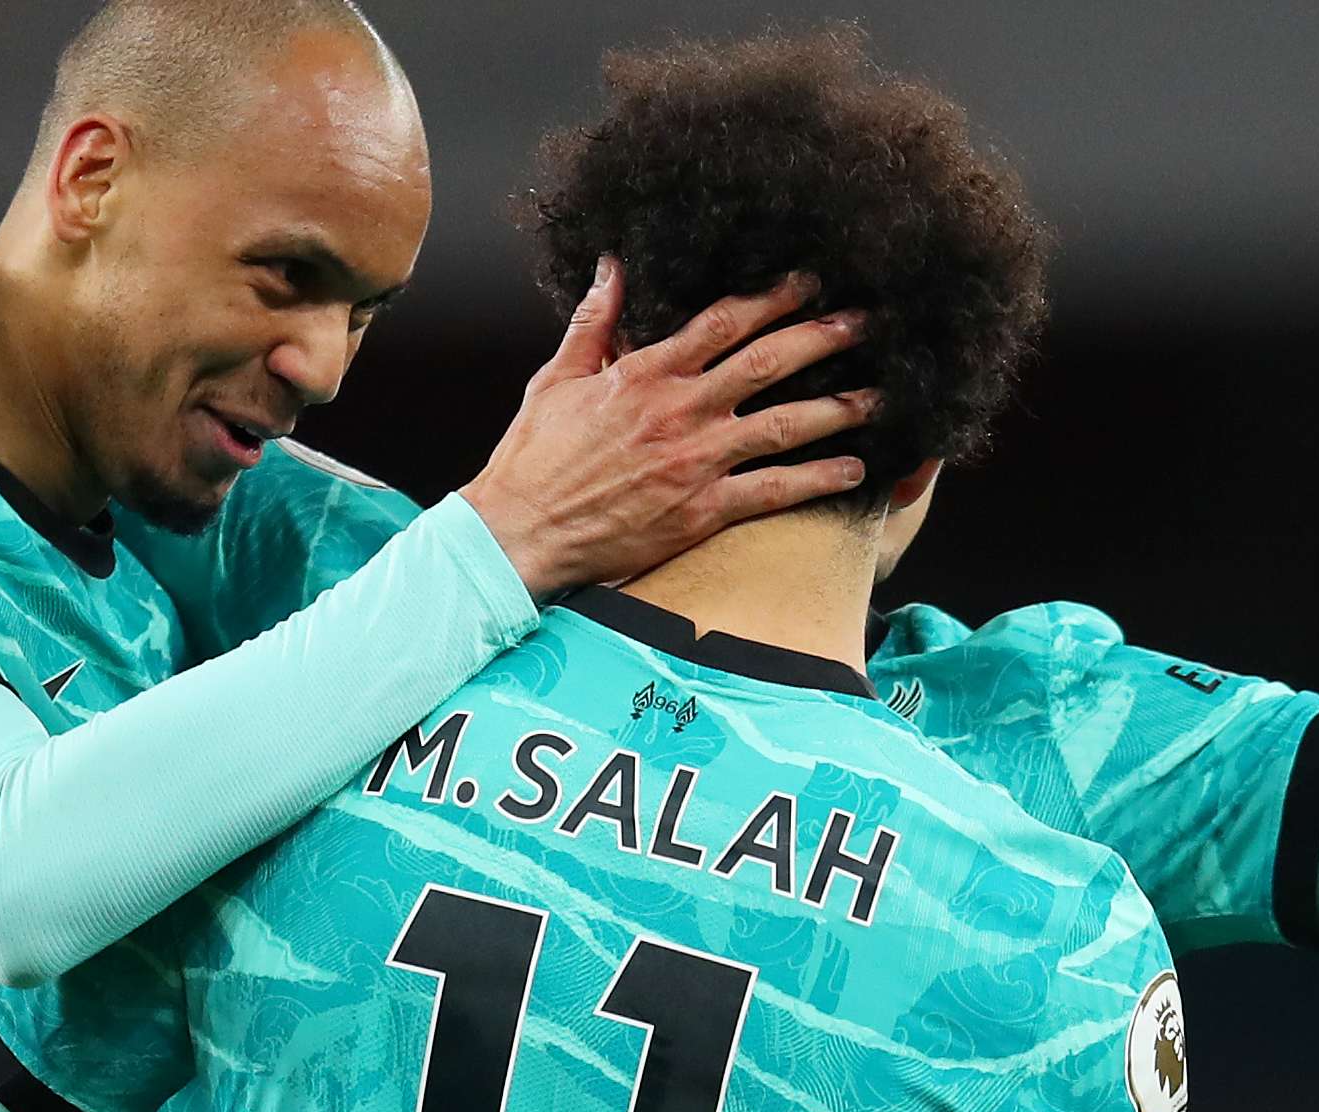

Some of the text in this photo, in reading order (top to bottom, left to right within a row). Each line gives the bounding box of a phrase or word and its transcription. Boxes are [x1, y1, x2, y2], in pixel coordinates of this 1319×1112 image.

[652, 695, 679, 715] 96
[362, 709, 901, 928] M. SALAH
